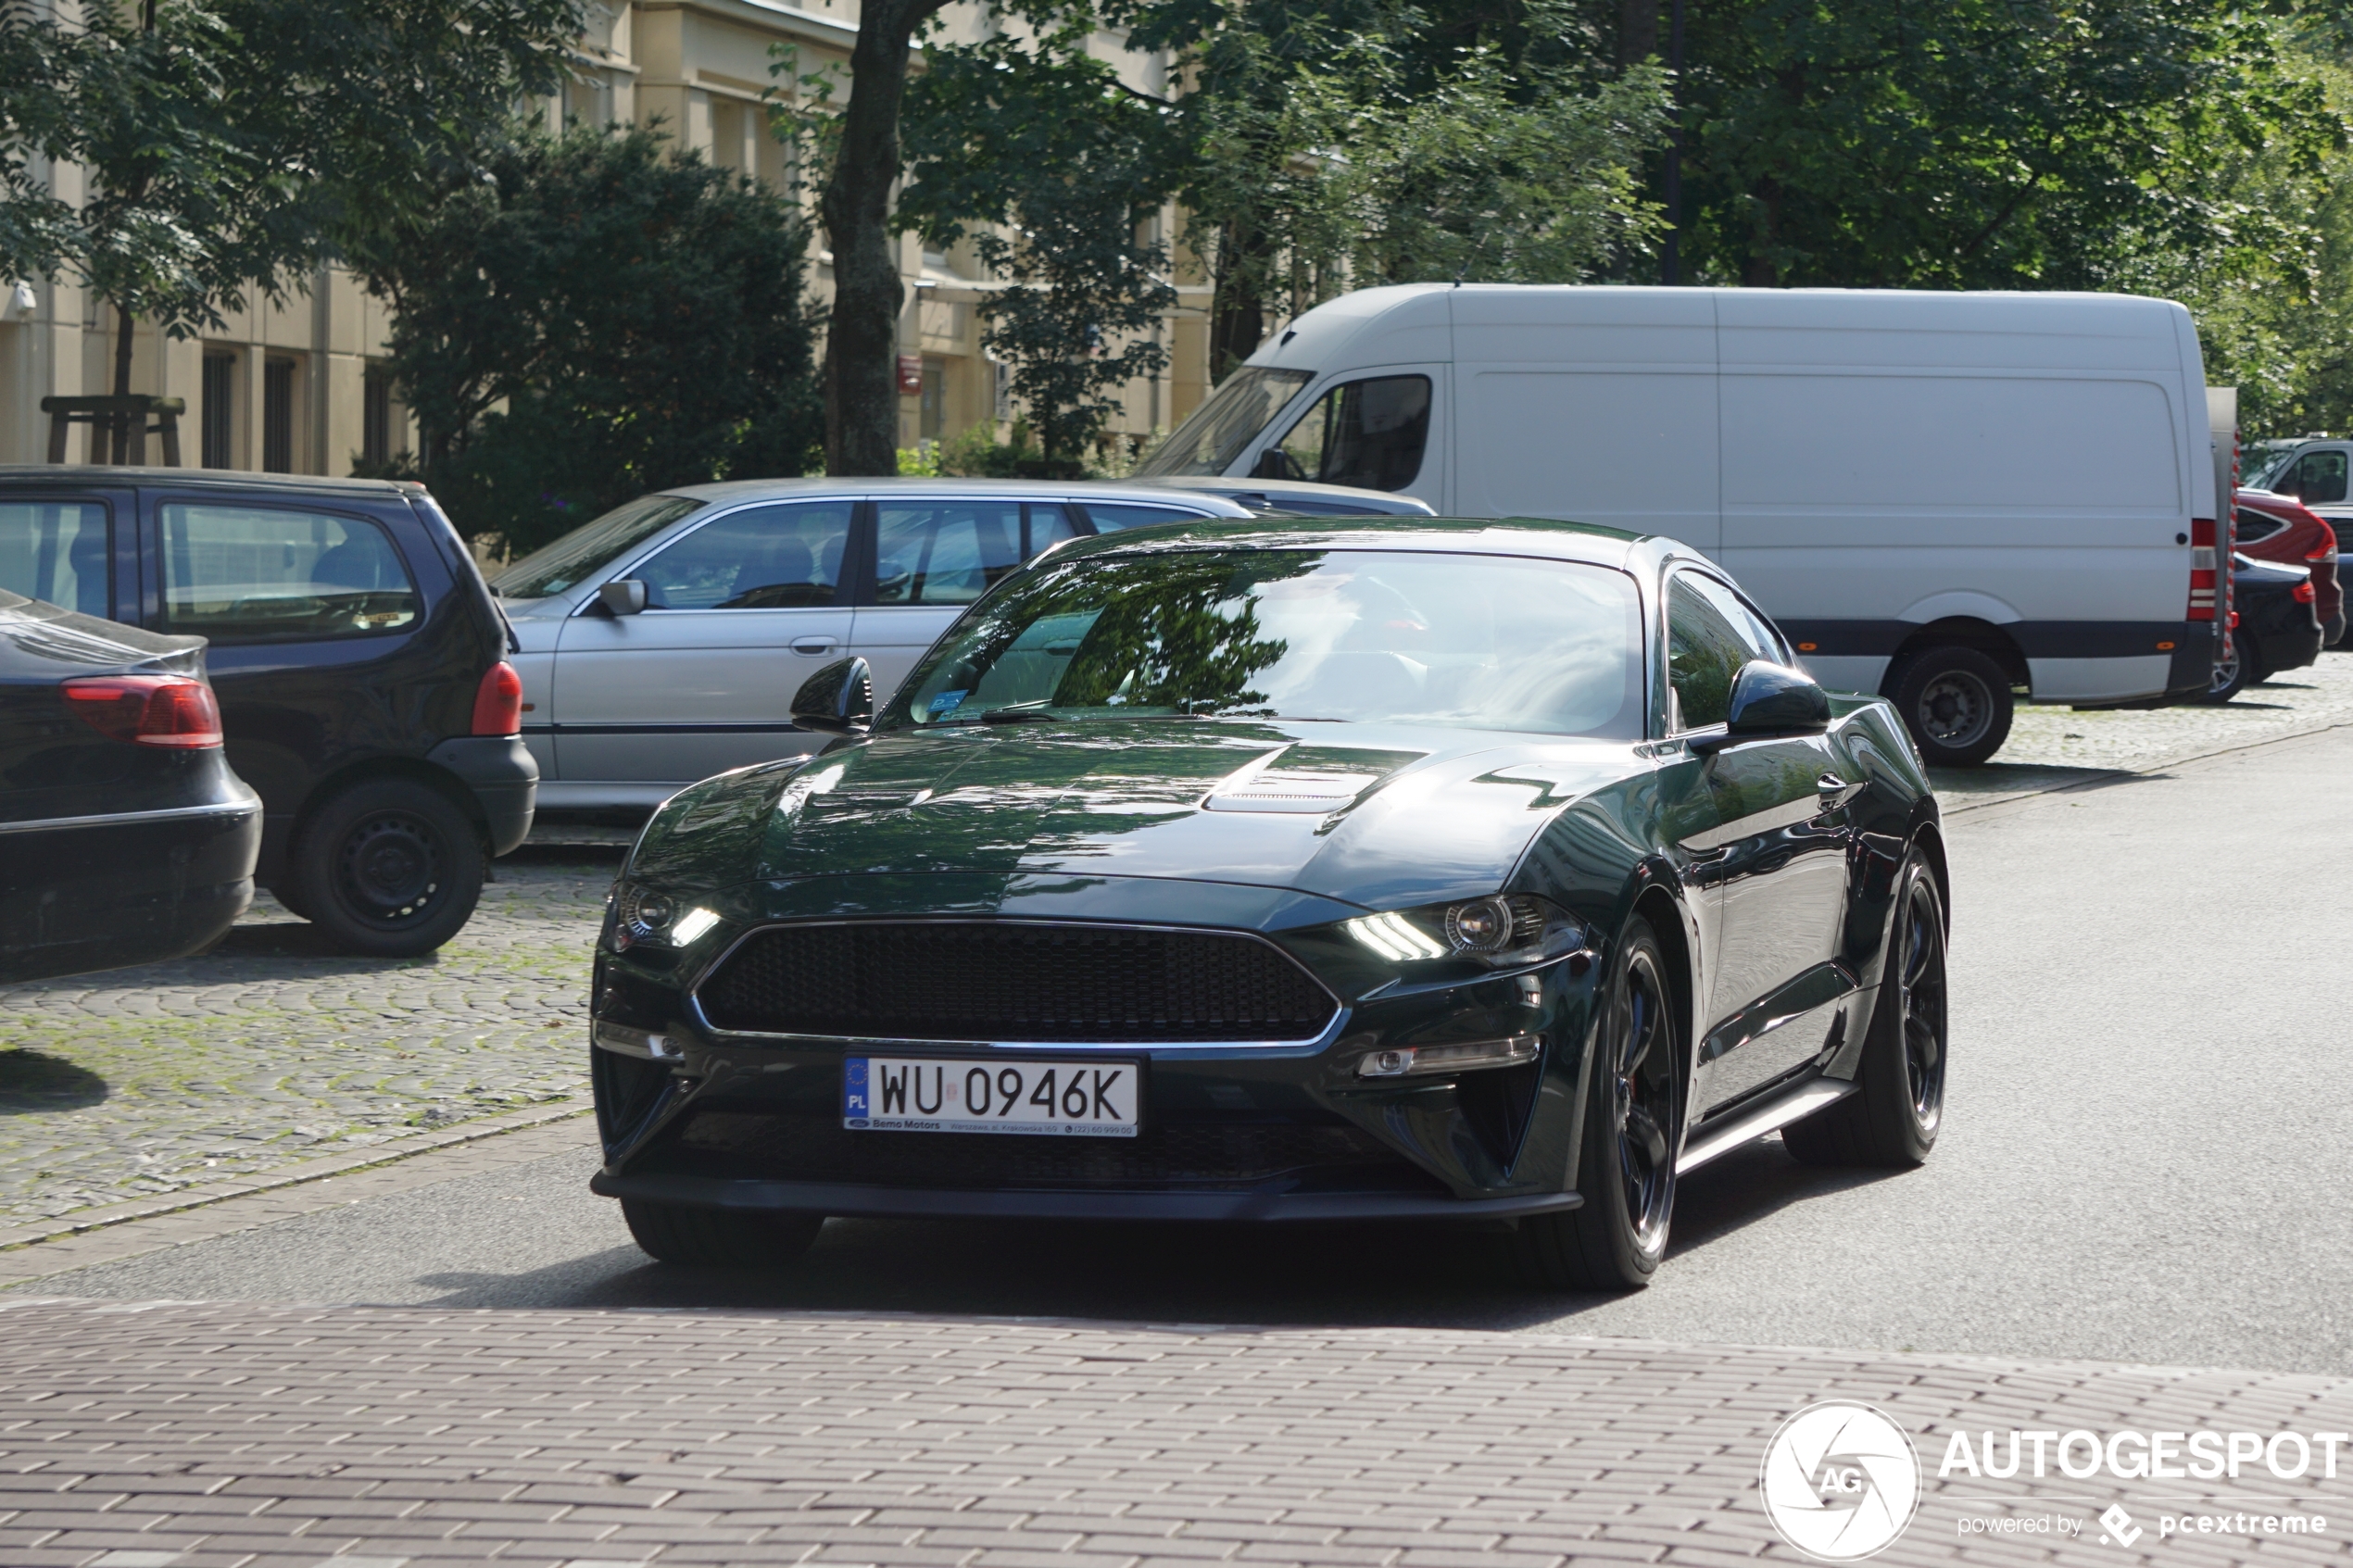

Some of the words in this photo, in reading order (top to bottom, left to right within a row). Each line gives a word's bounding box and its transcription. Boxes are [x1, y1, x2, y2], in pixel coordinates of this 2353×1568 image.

[881, 1064, 942, 1115] WU
[965, 1067, 1122, 1120] 0946K
[849, 1095, 866, 1110] PL
[873, 1119, 902, 1128] Bemo
[904, 1120, 940, 1130] Motors
[1075, 1125, 1090, 1135] (22)
